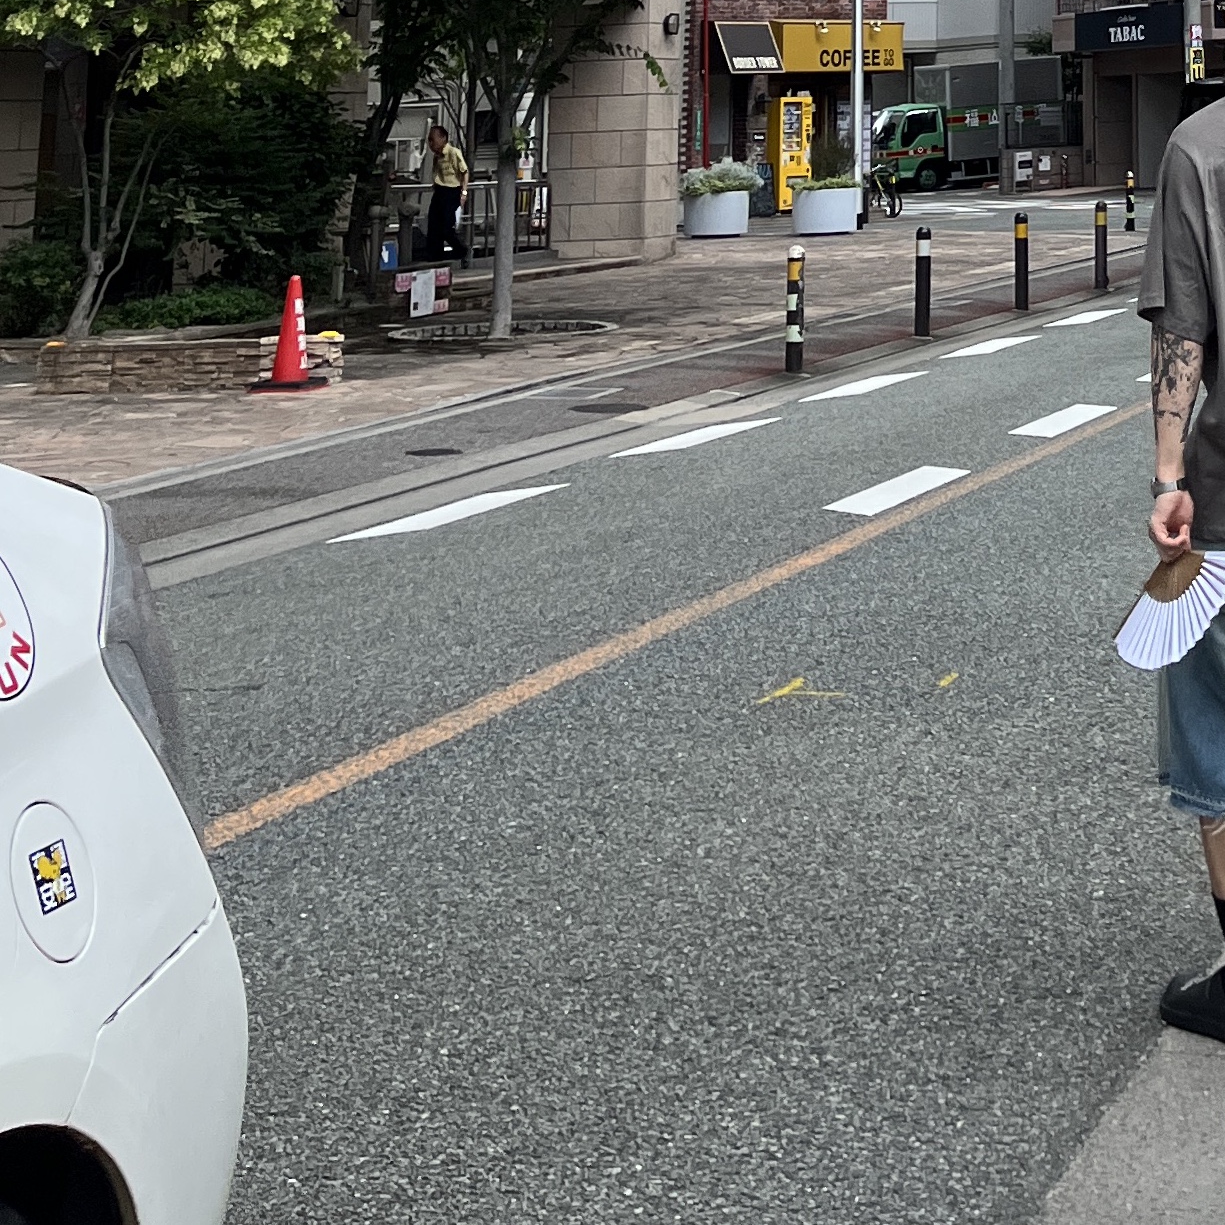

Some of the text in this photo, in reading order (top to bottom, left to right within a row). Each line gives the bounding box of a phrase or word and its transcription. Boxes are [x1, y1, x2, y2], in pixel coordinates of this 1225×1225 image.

[1108, 24, 1145, 43] TABAC
[819, 49, 881, 67] COFEE
[883, 49, 895, 57] TO
